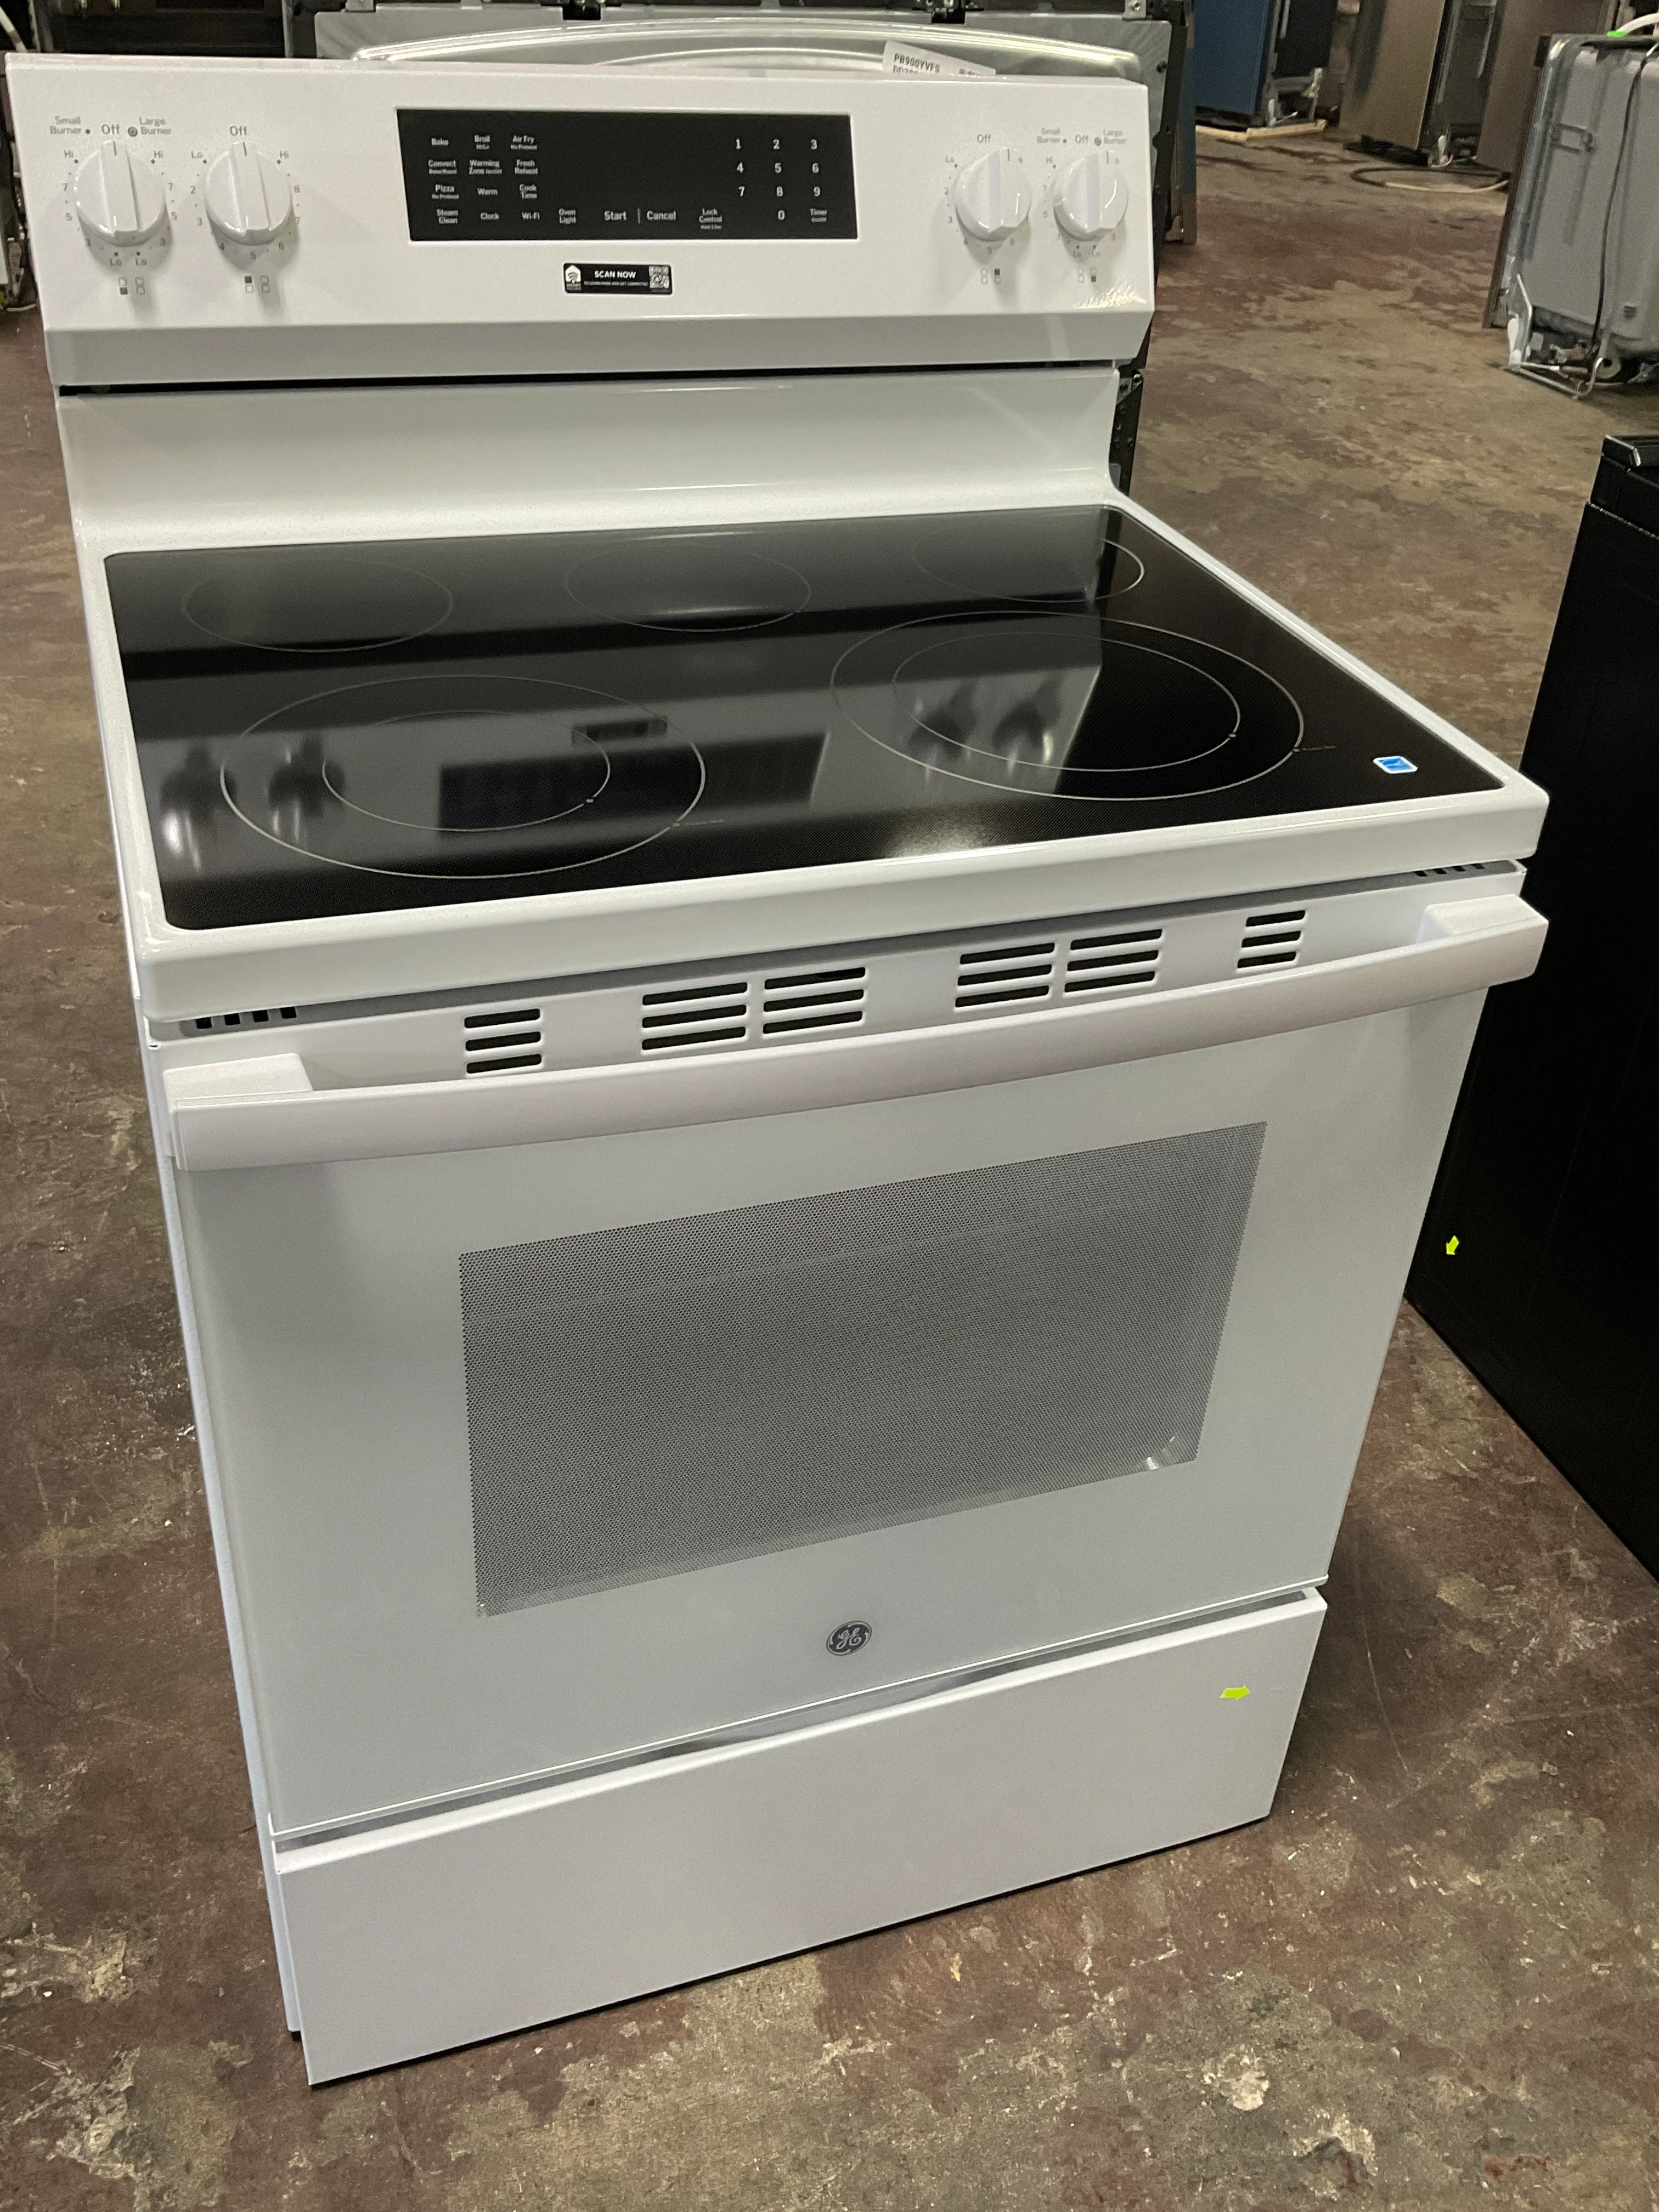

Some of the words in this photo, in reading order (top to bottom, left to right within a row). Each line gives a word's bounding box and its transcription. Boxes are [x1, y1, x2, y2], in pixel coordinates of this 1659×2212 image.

[55, 116, 81, 125] Small
[139, 117, 166, 127] Large
[50, 126, 82, 134] Burner
[101, 124, 120, 134] Off
[140, 127, 171, 135] Burner
[229, 125, 247, 136] Off
[523, 135, 534, 144] Fry
[977, 134, 991, 143] Off
[1075, 134, 1088, 143] Off
[736, 138, 741, 150] 1
[772, 139, 780, 150] 2
[811, 139, 818, 150] 3
[64, 150, 74, 158] Hi
[154, 150, 163, 158] Hi
[191, 150, 203, 159] Lo
[279, 150, 289, 159] Hi
[470, 159, 500, 167] Warming
[736, 162, 744, 173] 4
[775, 162, 782, 174] 5
[812, 162, 820, 174] 6
[62, 183, 68, 191] 7
[190, 185, 196, 194] 2
[519, 184, 537, 192] Cook
[738, 186, 745, 197] 7
[776, 186, 783, 197] 8
[813, 186, 821, 197] 9
[944, 187, 949, 195] 2
[65, 212, 72, 221] 5
[604, 211, 627, 221] Start
[646, 210, 676, 221] Cancel
[702, 208, 718, 216] Lock
[777, 210, 785, 221] 0
[195, 217, 203, 225] 3
[559, 216, 577, 224] Light
[219, 242, 224, 251] 4
[110, 258, 122, 267] Lo
[594, 270, 616, 279] SCAN
